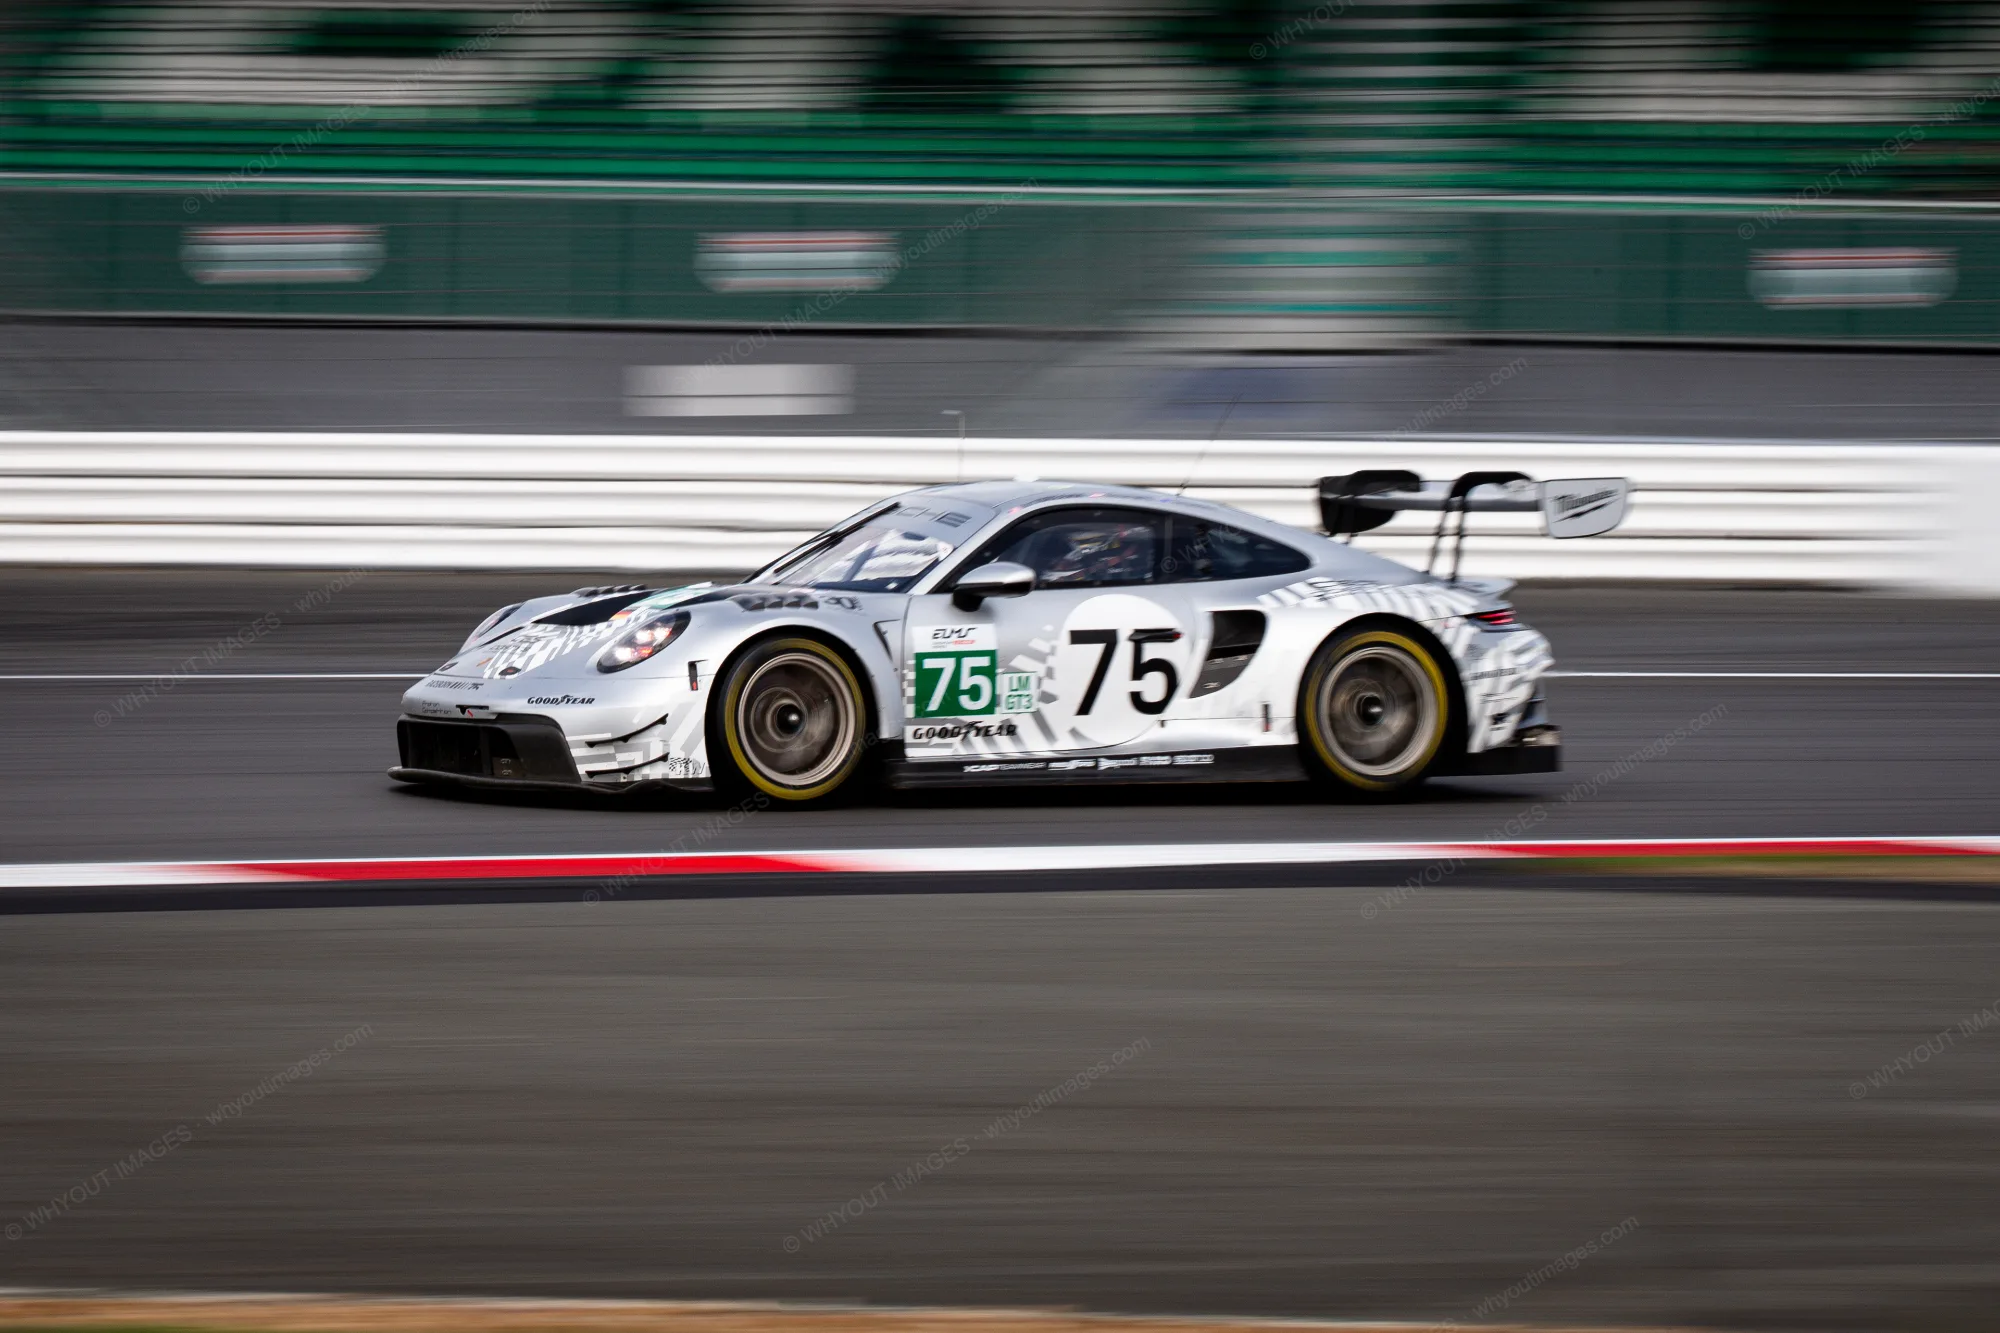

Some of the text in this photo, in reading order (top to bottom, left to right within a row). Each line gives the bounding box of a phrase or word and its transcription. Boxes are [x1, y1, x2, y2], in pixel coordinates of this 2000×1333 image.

[1069, 628, 1178, 716] 75
[922, 655, 994, 712] 75
[1010, 675, 1032, 692] LM
[527, 694, 595, 706] GOODYEAR
[1005, 693, 1034, 711] GT3
[913, 721, 1018, 741] GOODYEAR
